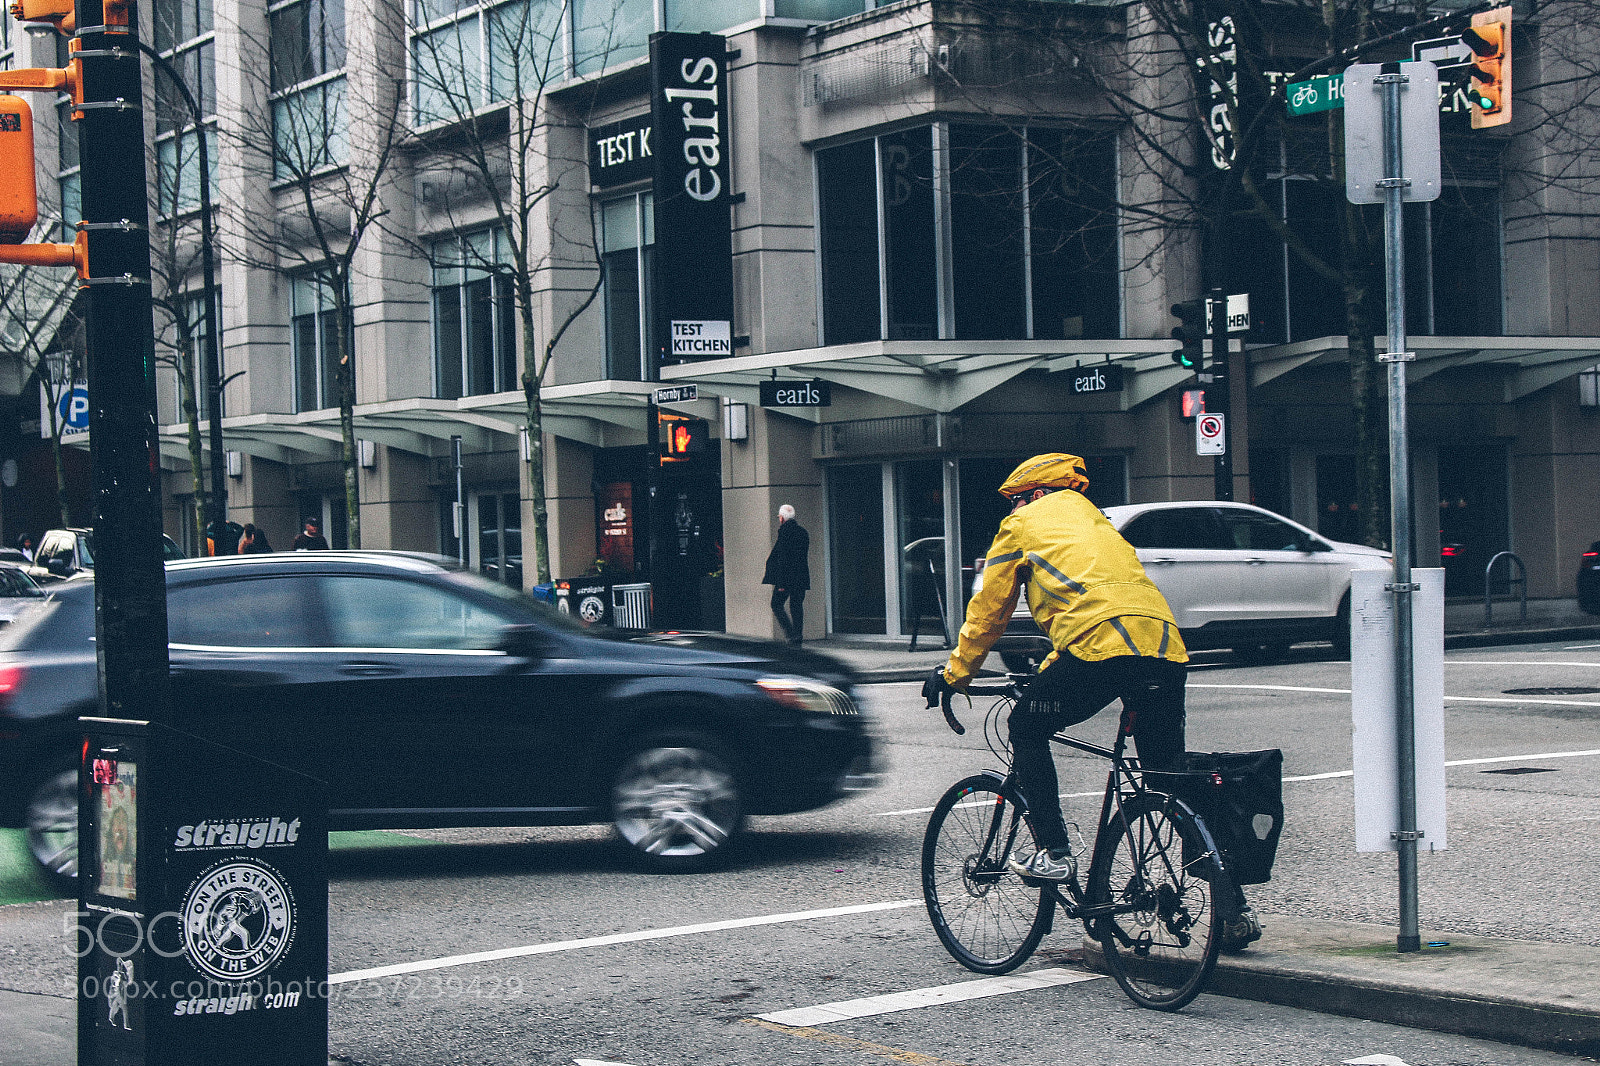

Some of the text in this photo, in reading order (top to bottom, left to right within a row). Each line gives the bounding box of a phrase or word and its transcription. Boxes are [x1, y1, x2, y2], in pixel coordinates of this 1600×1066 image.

[664, 57, 722, 201] earls
[597, 131, 635, 168] TEST
[673, 323, 703, 336] TEST
[673, 339, 730, 352] KITCHEN
[776, 383, 820, 404] earls
[1075, 369, 1106, 392] earls
[174, 816, 301, 849] straight
[194, 871, 284, 915] ON THE STREET
[198, 940, 216, 962] ON
[220, 957, 248, 972] THE
[250, 935, 279, 965] WEB
